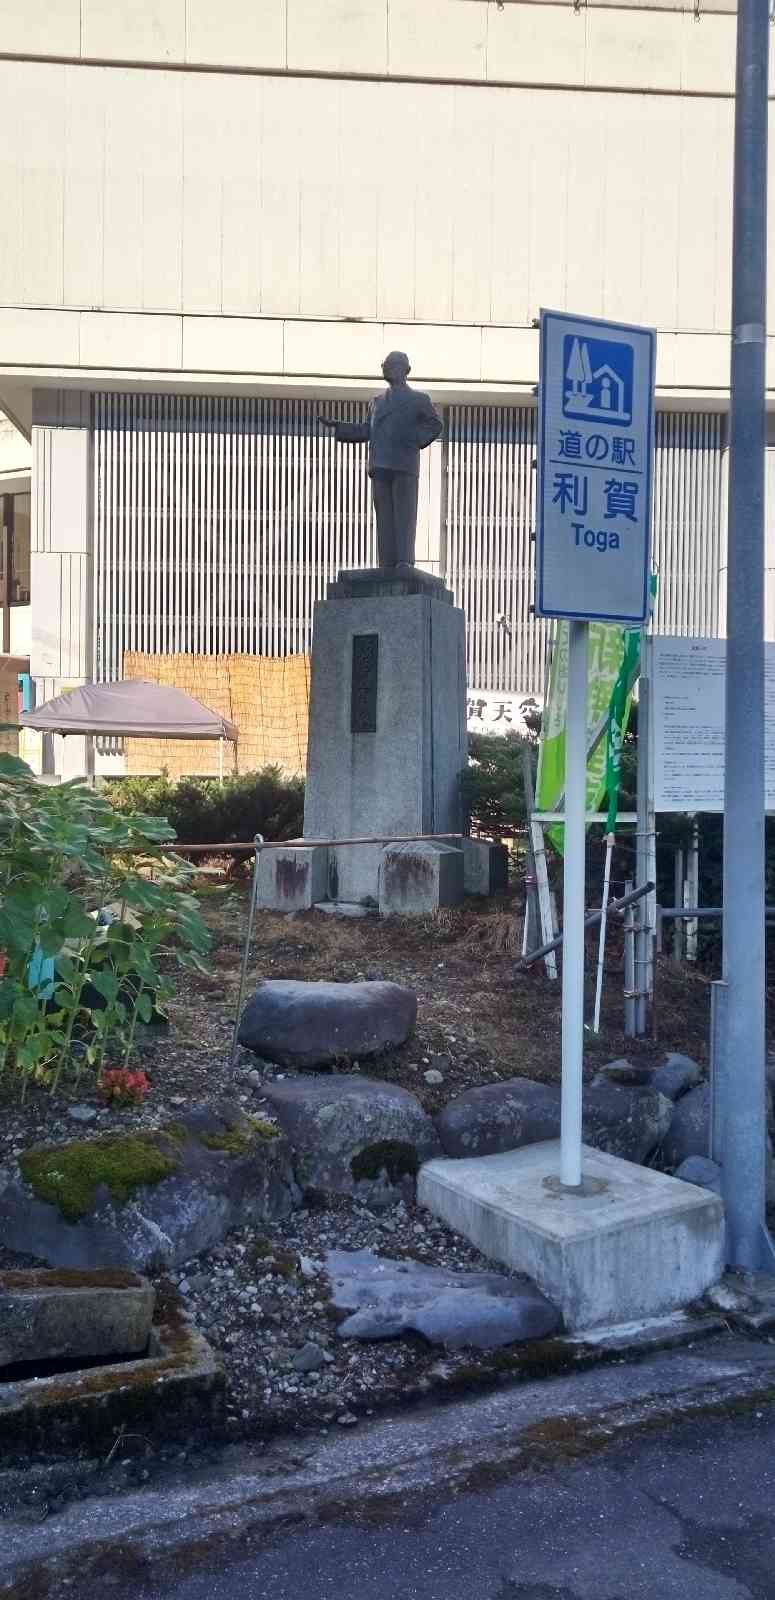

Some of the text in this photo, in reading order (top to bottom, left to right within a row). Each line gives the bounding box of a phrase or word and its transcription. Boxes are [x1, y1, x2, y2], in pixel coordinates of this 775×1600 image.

[558, 430, 635, 466] 道の駅
[552, 473, 639, 523] 利賀
[571, 523, 620, 553] Toga
